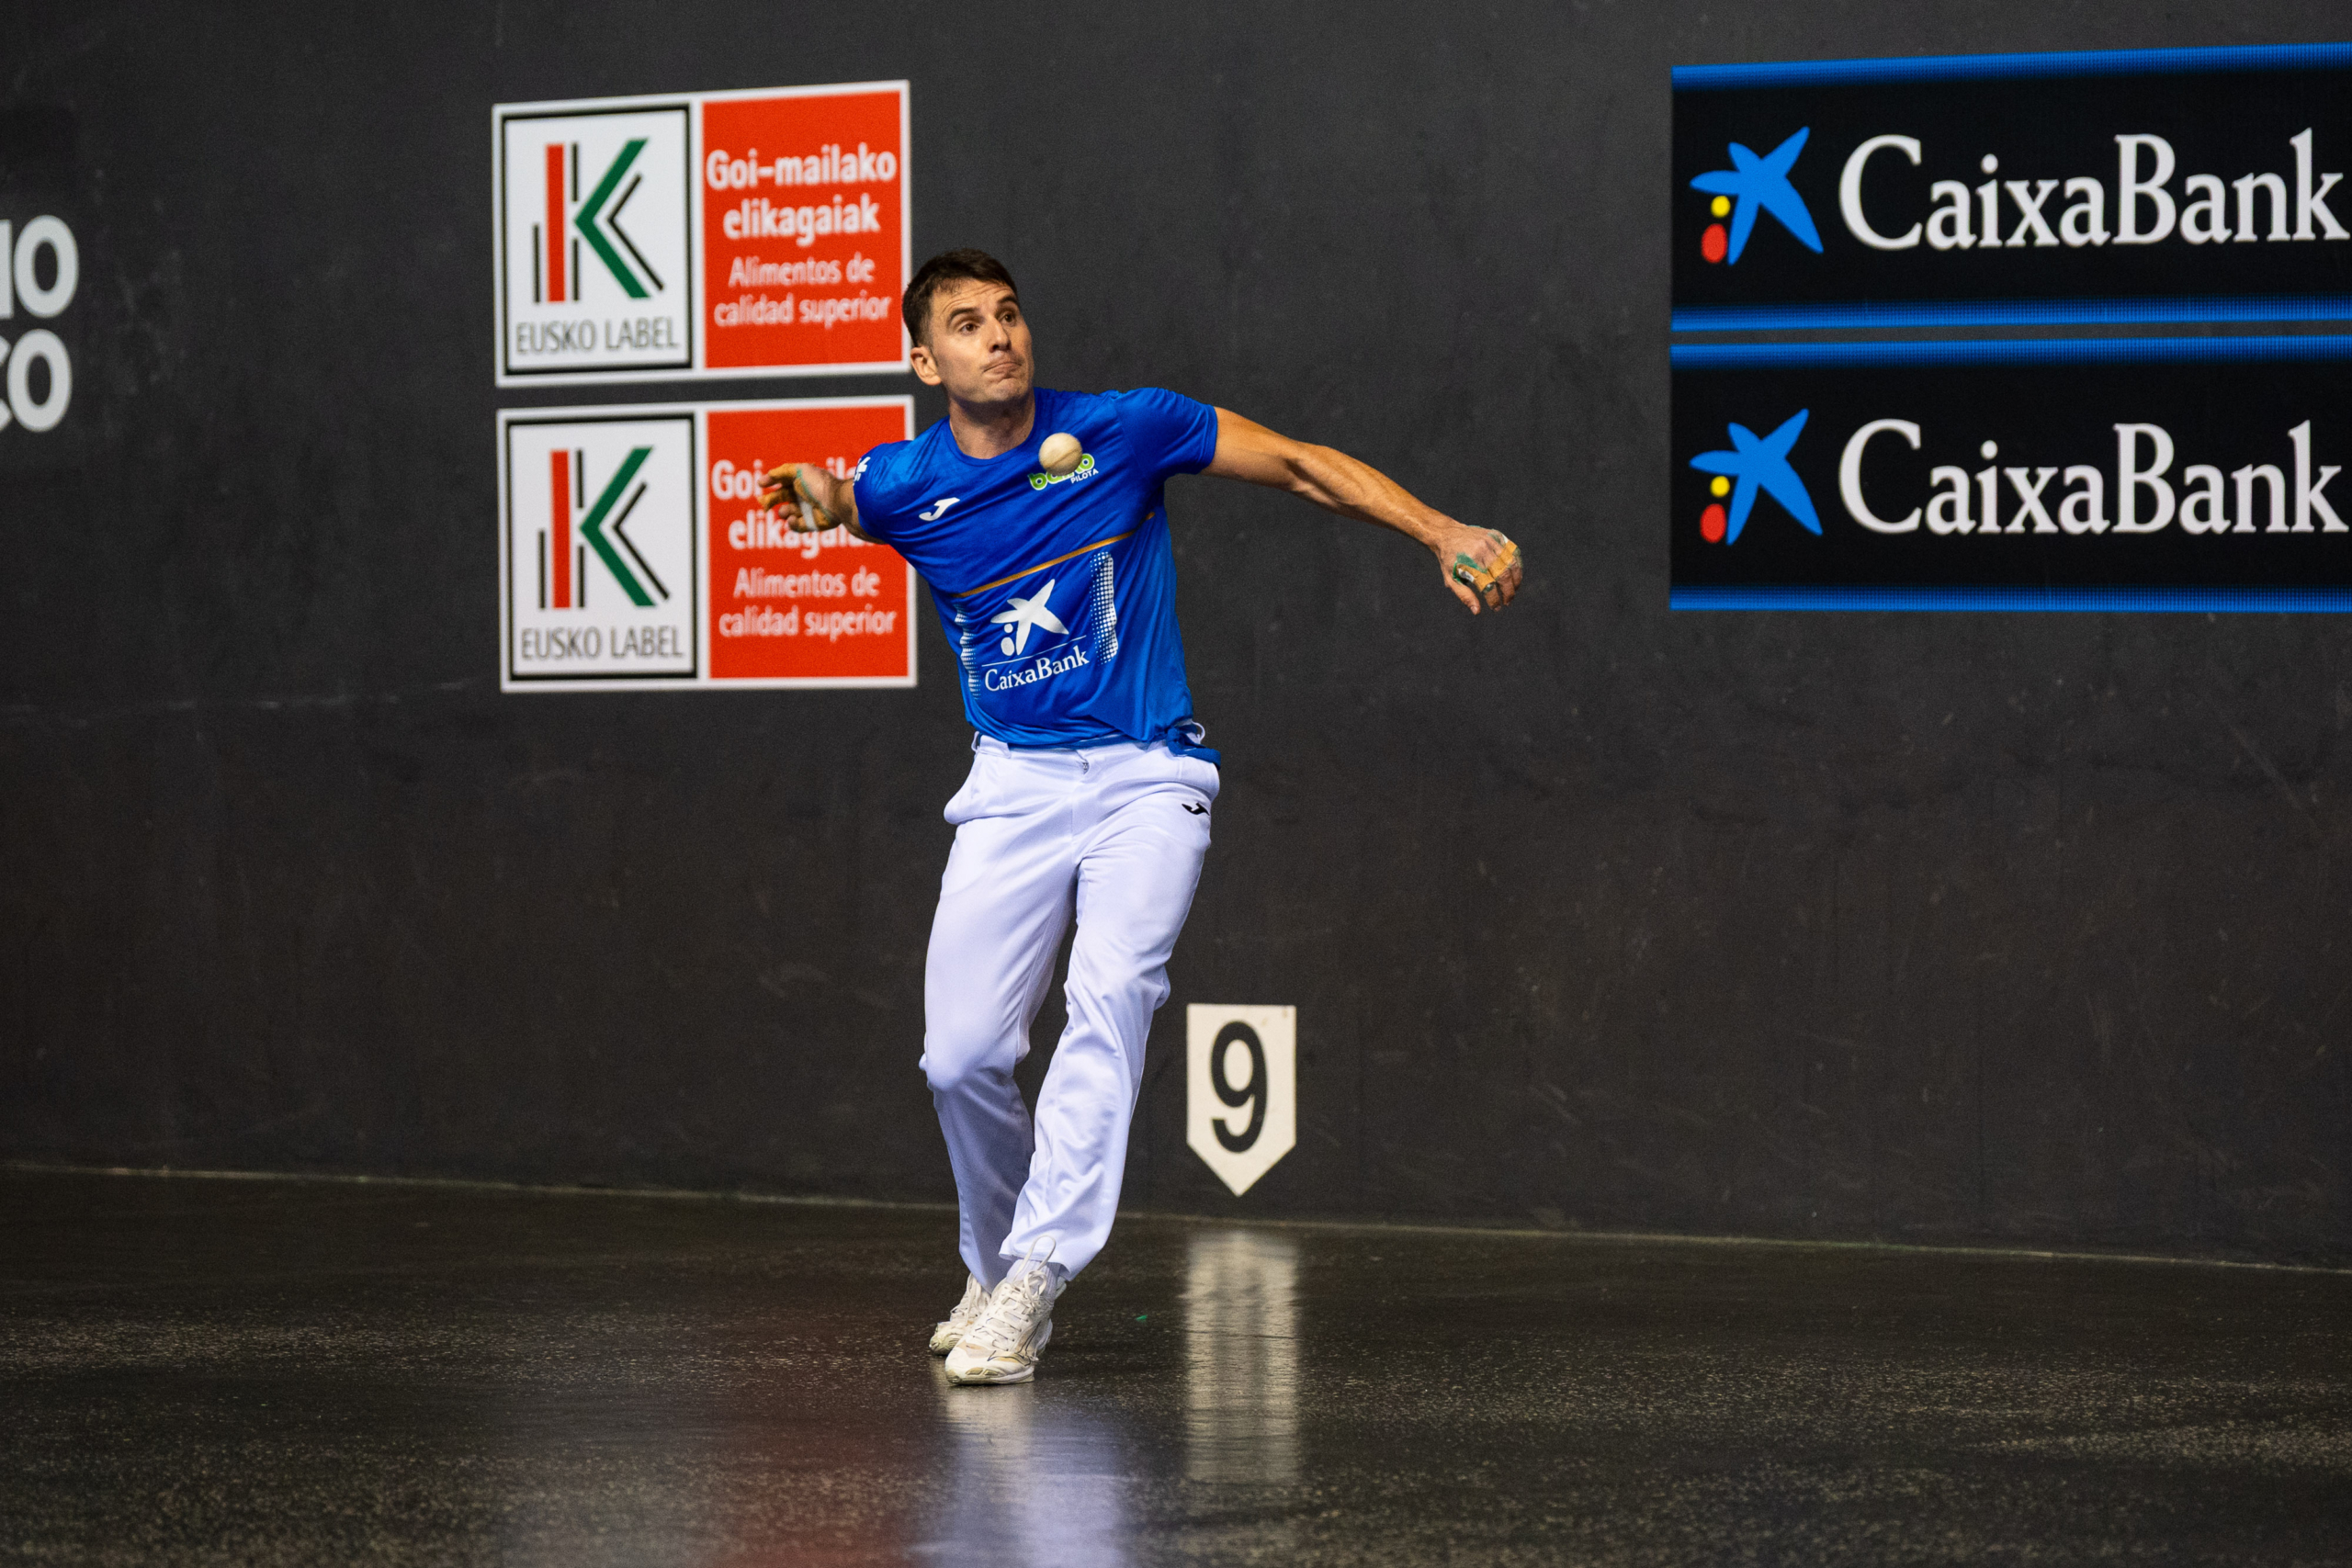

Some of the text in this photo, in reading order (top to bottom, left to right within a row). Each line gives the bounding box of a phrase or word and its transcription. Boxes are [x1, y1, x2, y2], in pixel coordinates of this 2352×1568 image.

[707, 142, 897, 191] Goi-mailako
[1838, 128, 2349, 250] CaixaBank
[723, 193, 880, 246] elikagaiak
[729, 252, 875, 288] Alimentos de
[714, 289, 891, 329] calidad superior
[516, 317, 678, 354] EUSKO LABEL
[1070, 468, 1099, 484] PILOTA
[1838, 418, 2349, 535] CaixaBank
[733, 565, 880, 598] Alimentos de
[521, 624, 684, 660] EUSKO LABEL
[718, 603, 897, 642] calidad superior
[985, 645, 1090, 692] CaixaBank
[1210, 1020, 1268, 1154] 9
